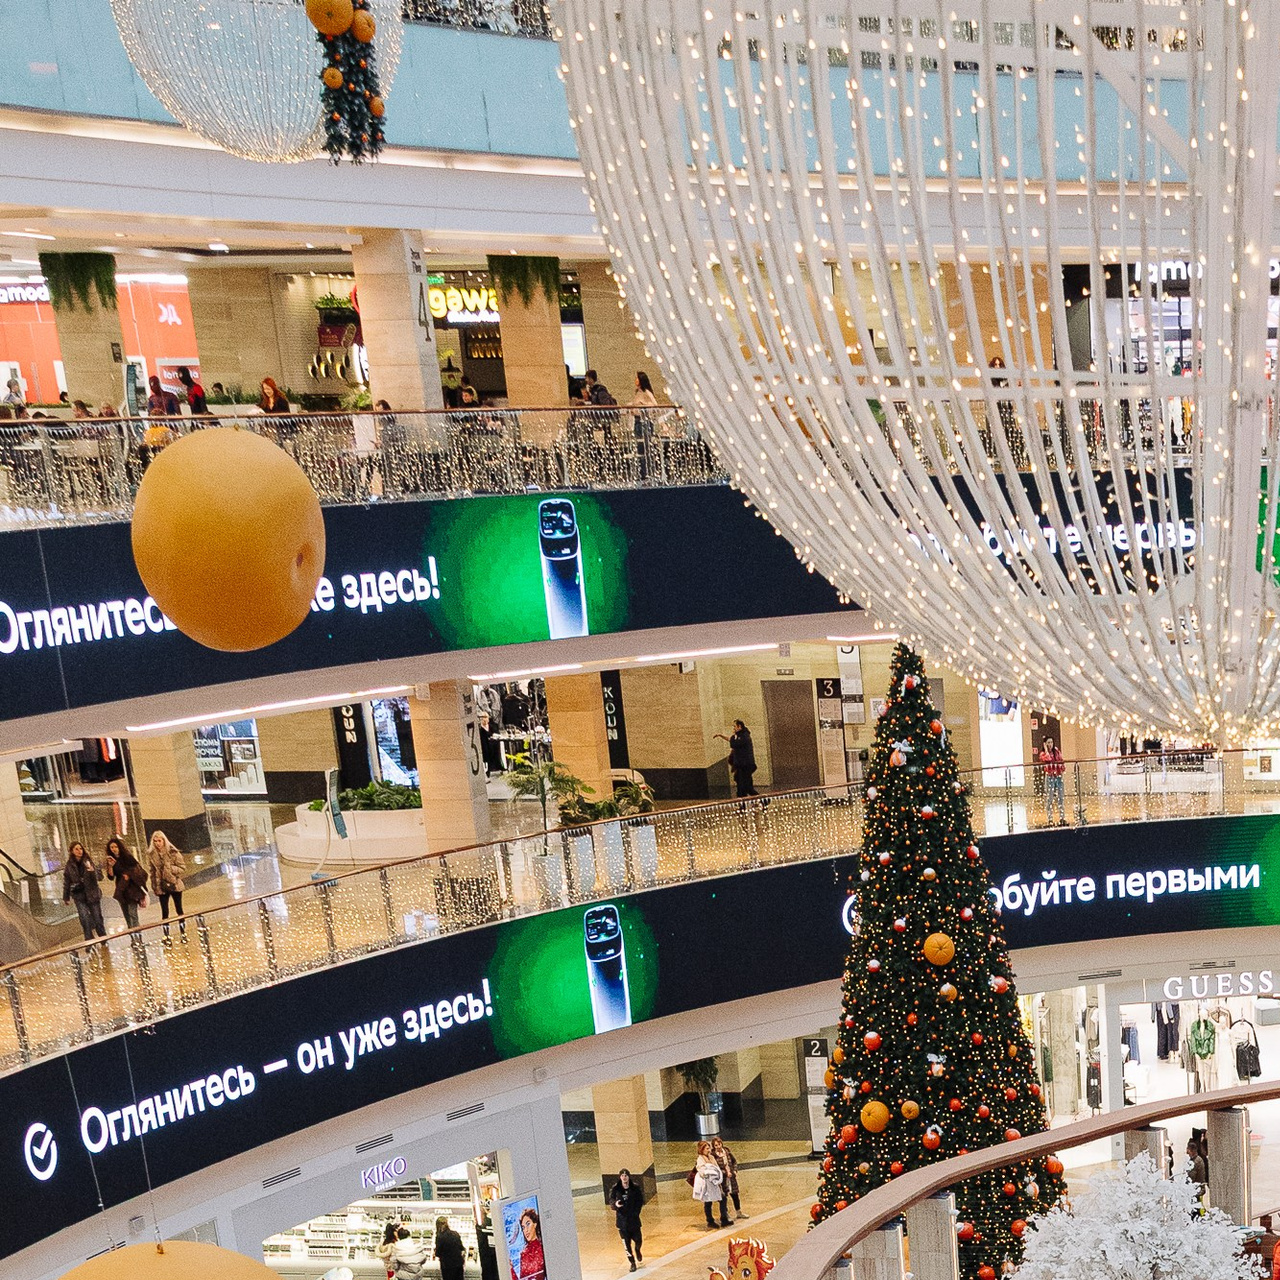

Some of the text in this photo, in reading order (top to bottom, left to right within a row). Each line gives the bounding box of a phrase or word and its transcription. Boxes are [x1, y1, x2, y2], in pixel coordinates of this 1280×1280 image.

[343, 555, 440, 614] здесь!
[823, 680, 834, 697] 3
[341, 705, 358, 744] OUN
[988, 863, 1261, 916] обуйте первыми
[1163, 969, 1273, 1000] GUESS
[81, 1063, 257, 1154] Оглянитесь
[297, 1037, 336, 1075] он
[338, 1015, 398, 1071] уже
[401, 977, 495, 1043] здесь!
[811, 1040, 821, 1056] 2
[361, 1156, 408, 1189] KIKO
